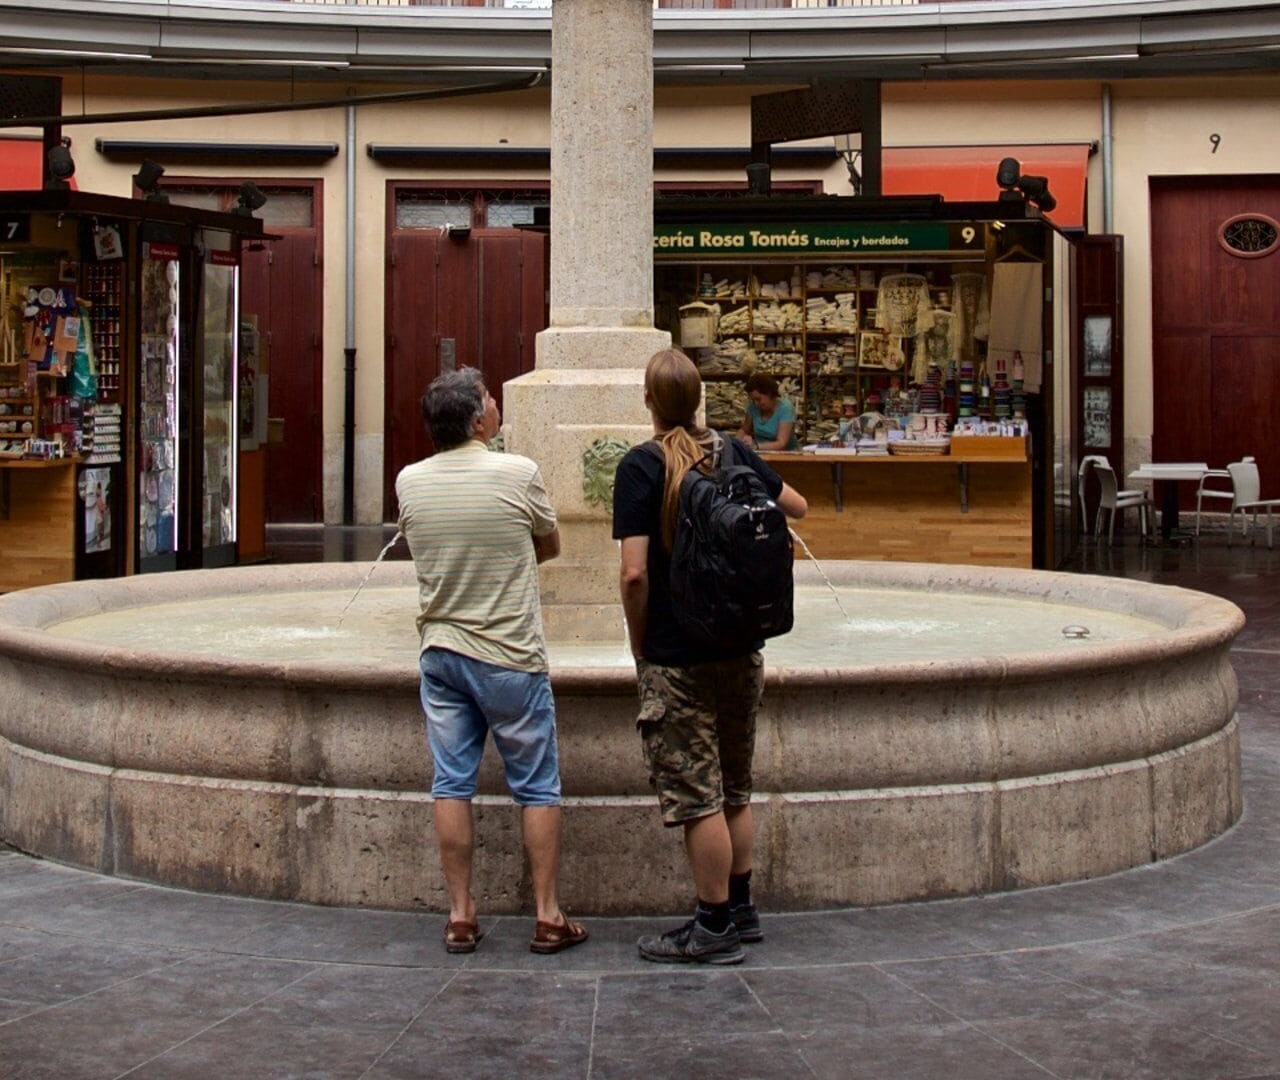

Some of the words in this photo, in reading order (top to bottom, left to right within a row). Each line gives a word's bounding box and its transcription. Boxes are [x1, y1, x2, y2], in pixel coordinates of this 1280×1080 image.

[1209, 133, 1221, 154] 9
[6, 222, 19, 239] 7
[700, 231, 745, 247] Rosa
[749, 229, 809, 247] Tomás
[814, 236, 850, 248] Encajes
[852, 238, 859, 248] y
[862, 235, 909, 246] bordados
[961, 226, 976, 244] 9
